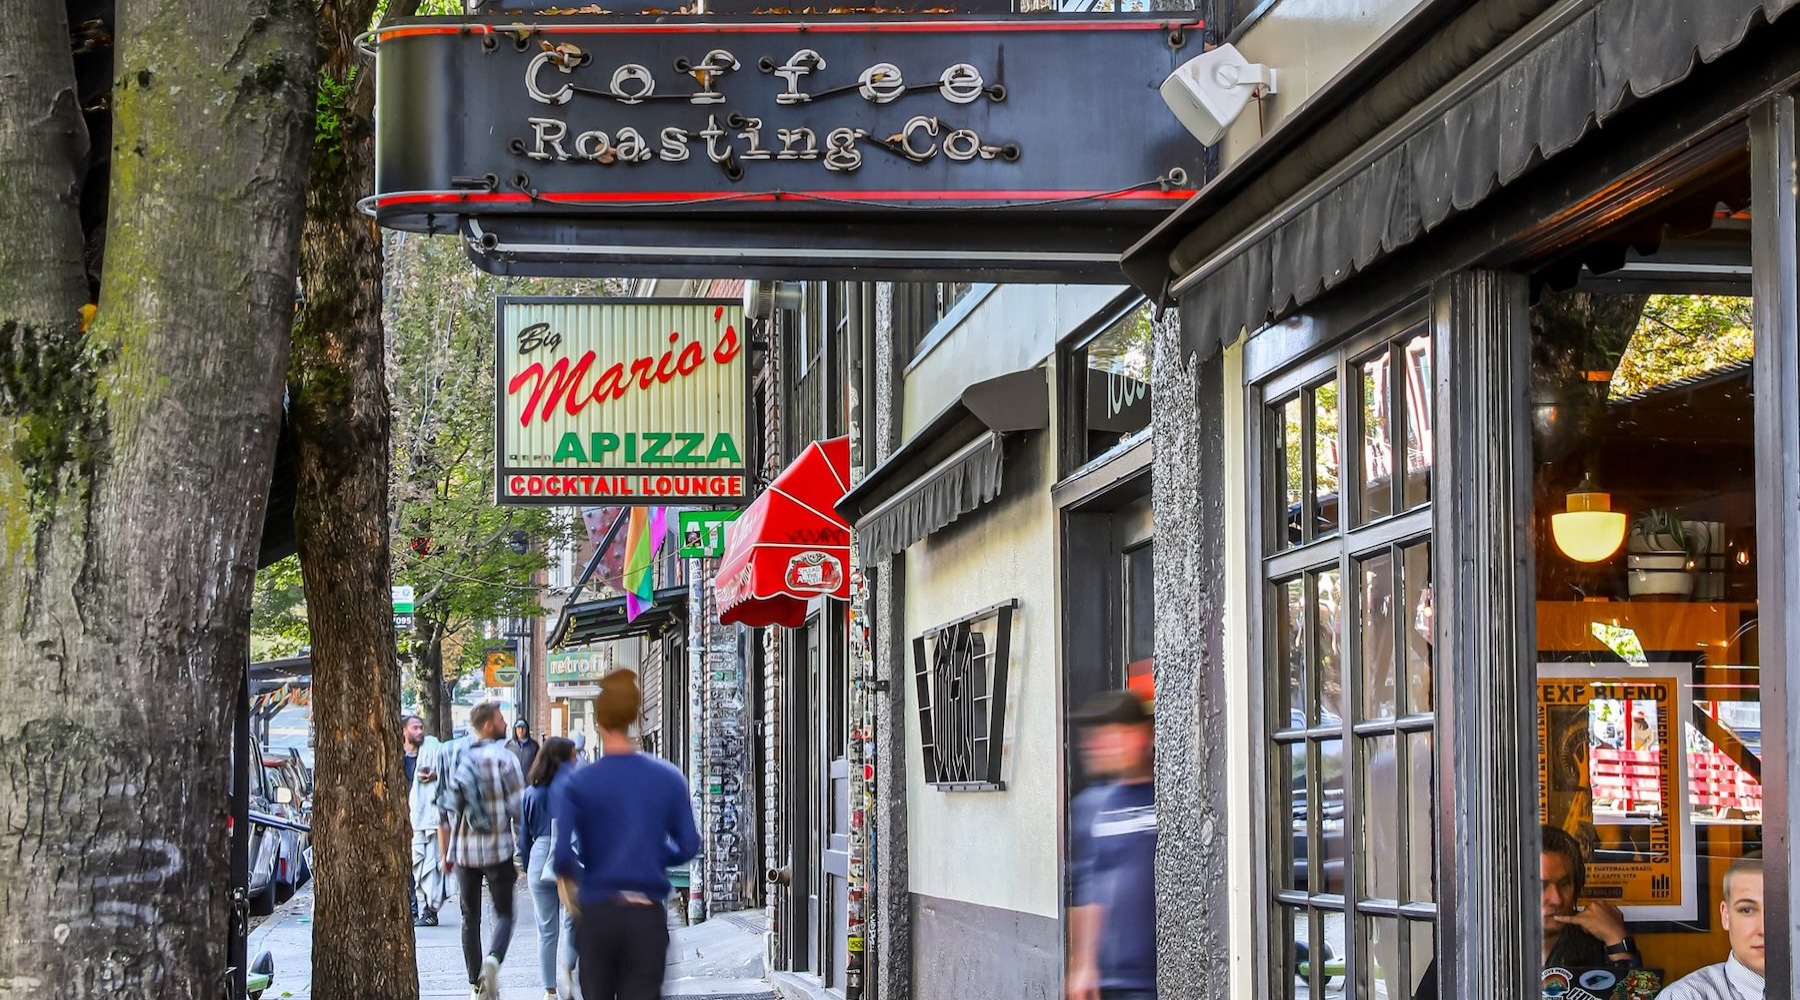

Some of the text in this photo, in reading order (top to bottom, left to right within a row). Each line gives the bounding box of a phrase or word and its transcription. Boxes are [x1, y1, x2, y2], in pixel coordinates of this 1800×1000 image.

[525, 48, 983, 104] Coffee
[528, 114, 867, 171] Roasting
[518, 322, 562, 355] Big
[509, 306, 742, 427] Mario's
[552, 432, 741, 464] APIZZA
[510, 475, 741, 496] COCKTAIL LOUNGE
[1594, 684, 1667, 702] BLEND
